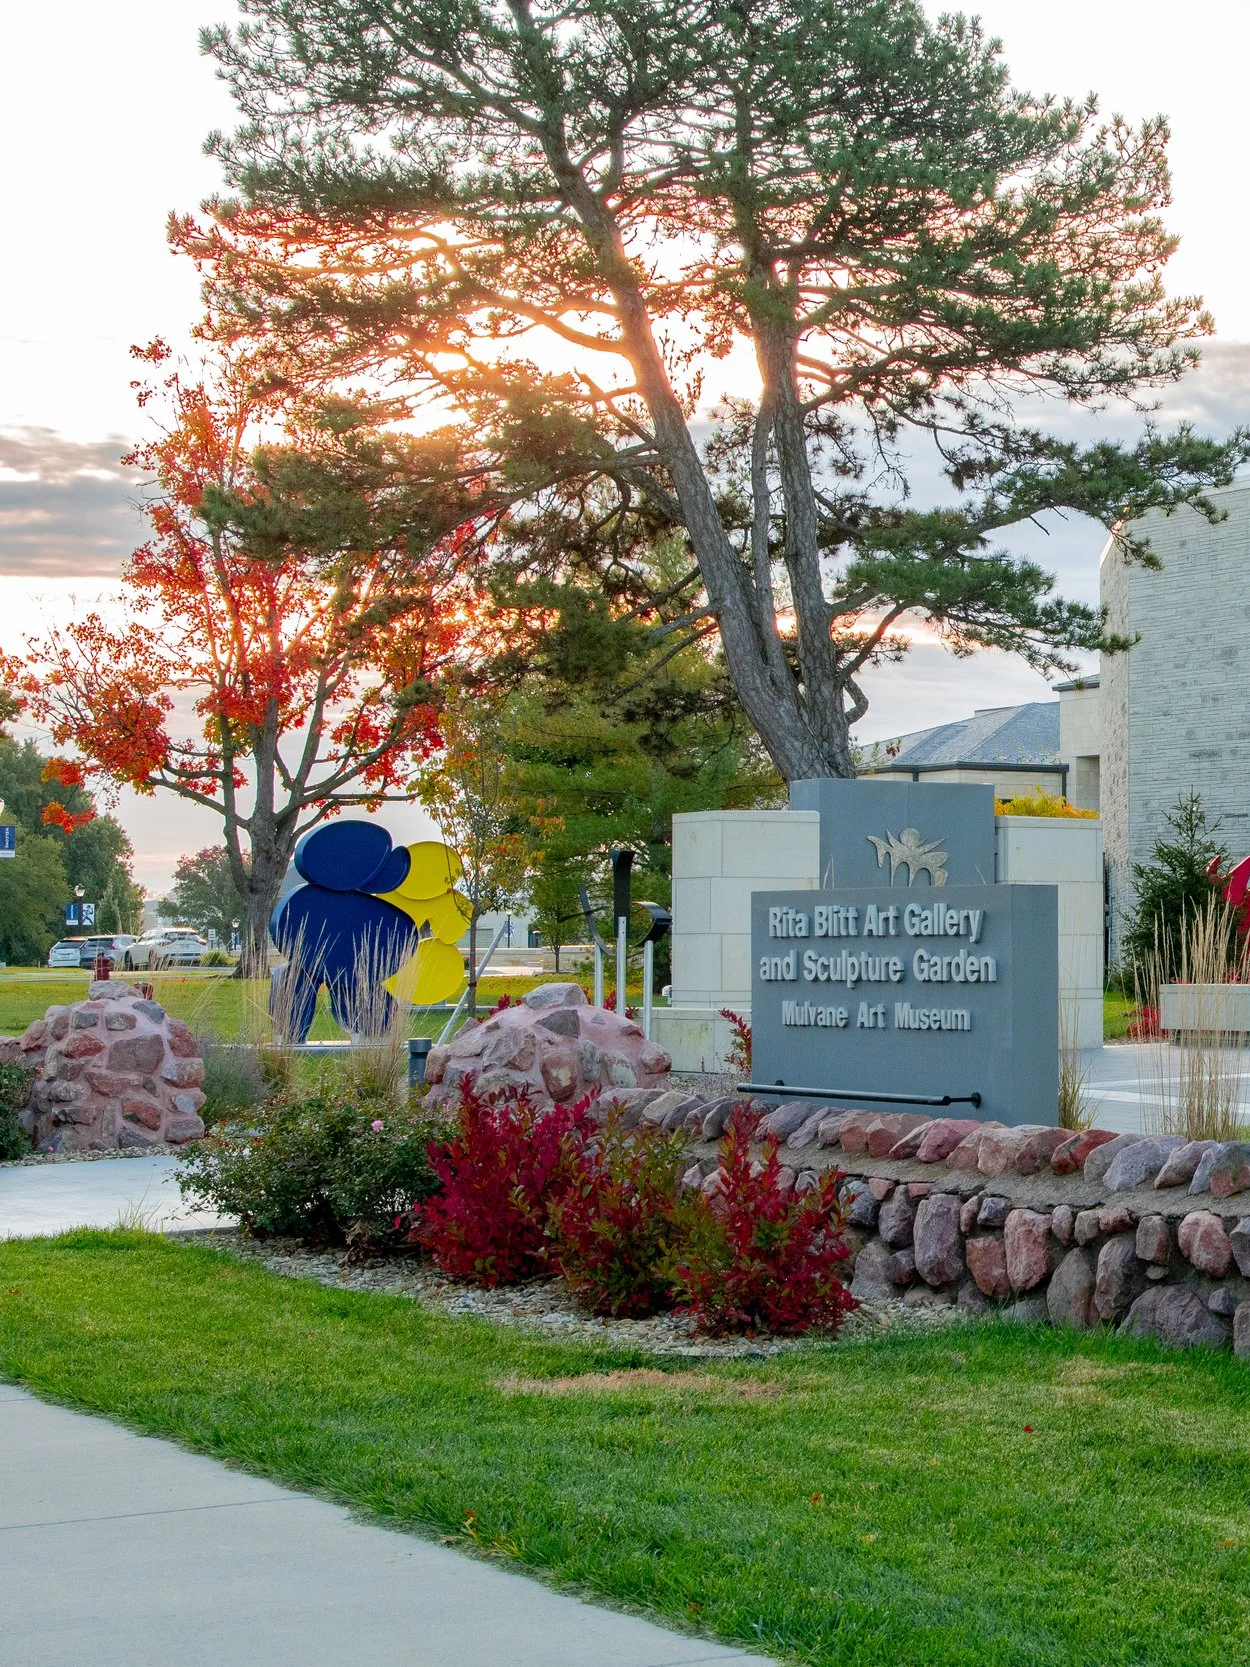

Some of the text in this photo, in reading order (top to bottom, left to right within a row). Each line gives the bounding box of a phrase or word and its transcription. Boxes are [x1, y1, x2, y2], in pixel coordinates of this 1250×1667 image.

[768, 903, 985, 943] Rita Blitt Art Gallery
[759, 948, 997, 988] and Sculpture Garden
[781, 1000, 971, 1031] Mulvane Art Museum
